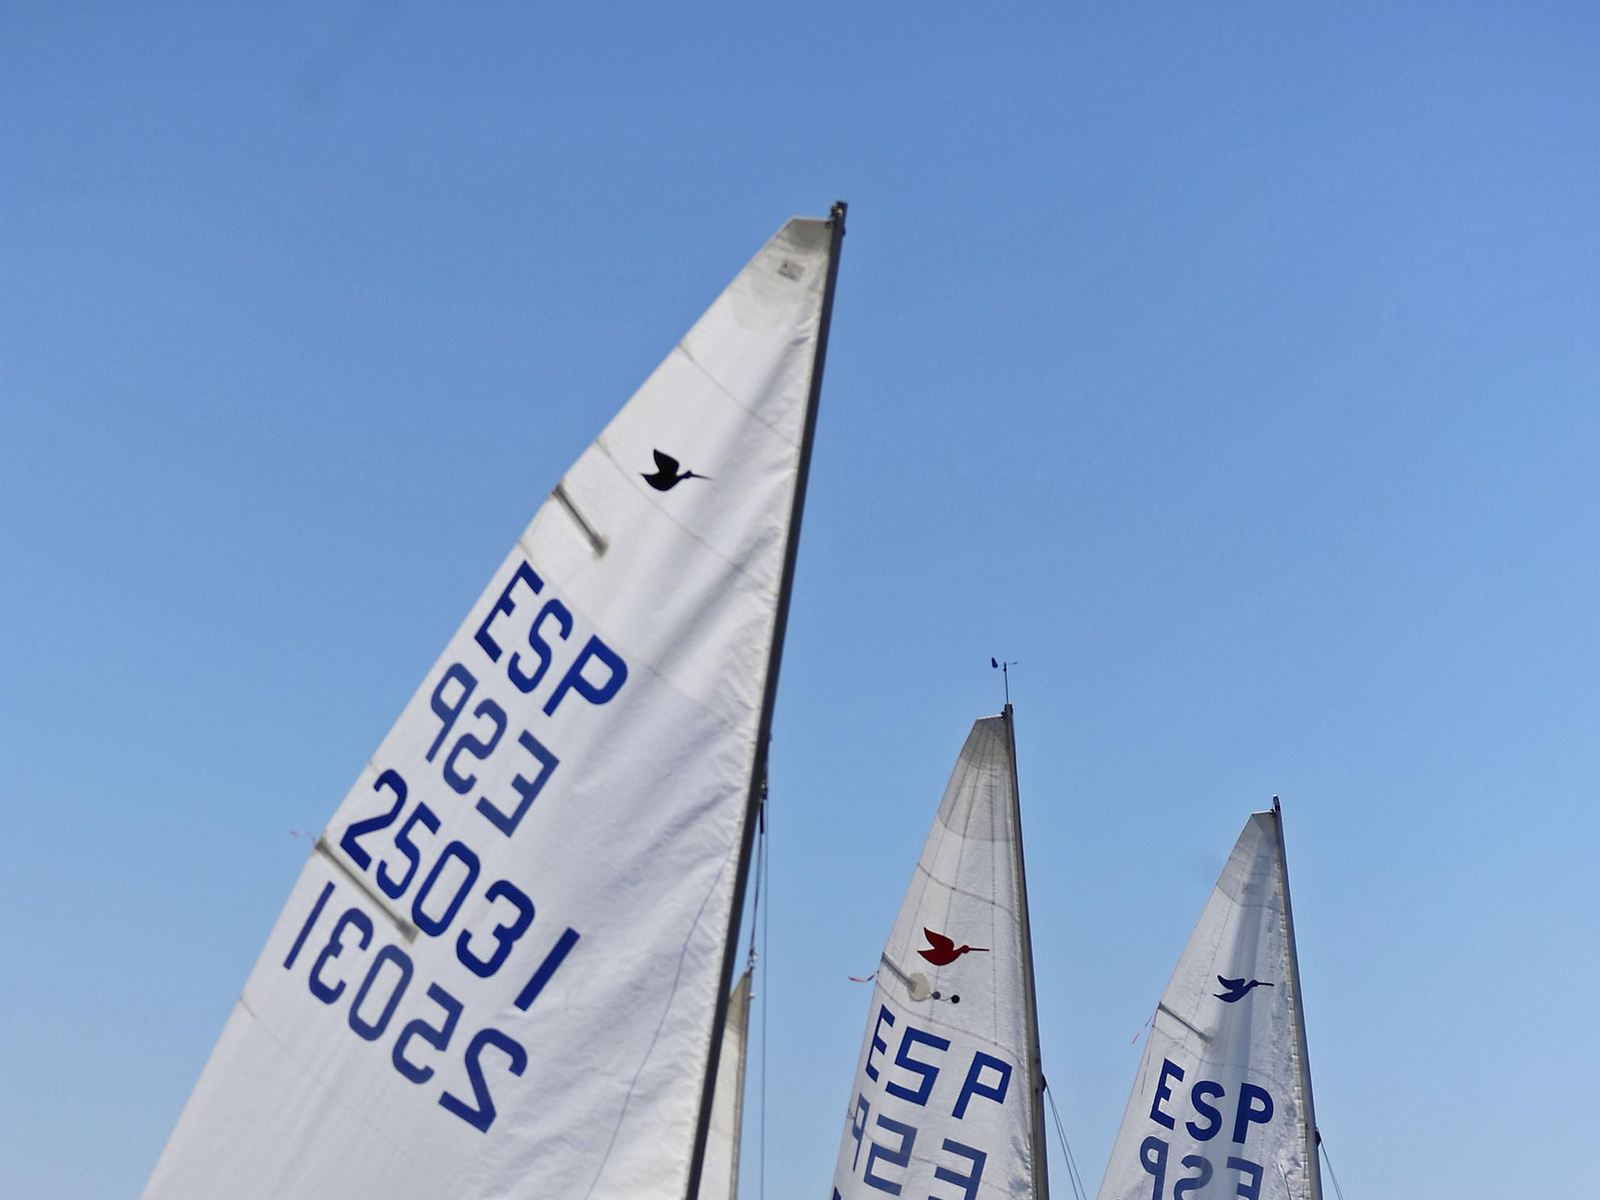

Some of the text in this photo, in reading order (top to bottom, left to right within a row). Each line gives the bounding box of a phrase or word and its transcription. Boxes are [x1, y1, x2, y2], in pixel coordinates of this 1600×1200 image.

[473, 560, 629, 718] ESP
[339, 768, 581, 1012] 25031
[865, 1003, 1013, 1120] ESP
[1149, 1057, 1275, 1144] ESP
